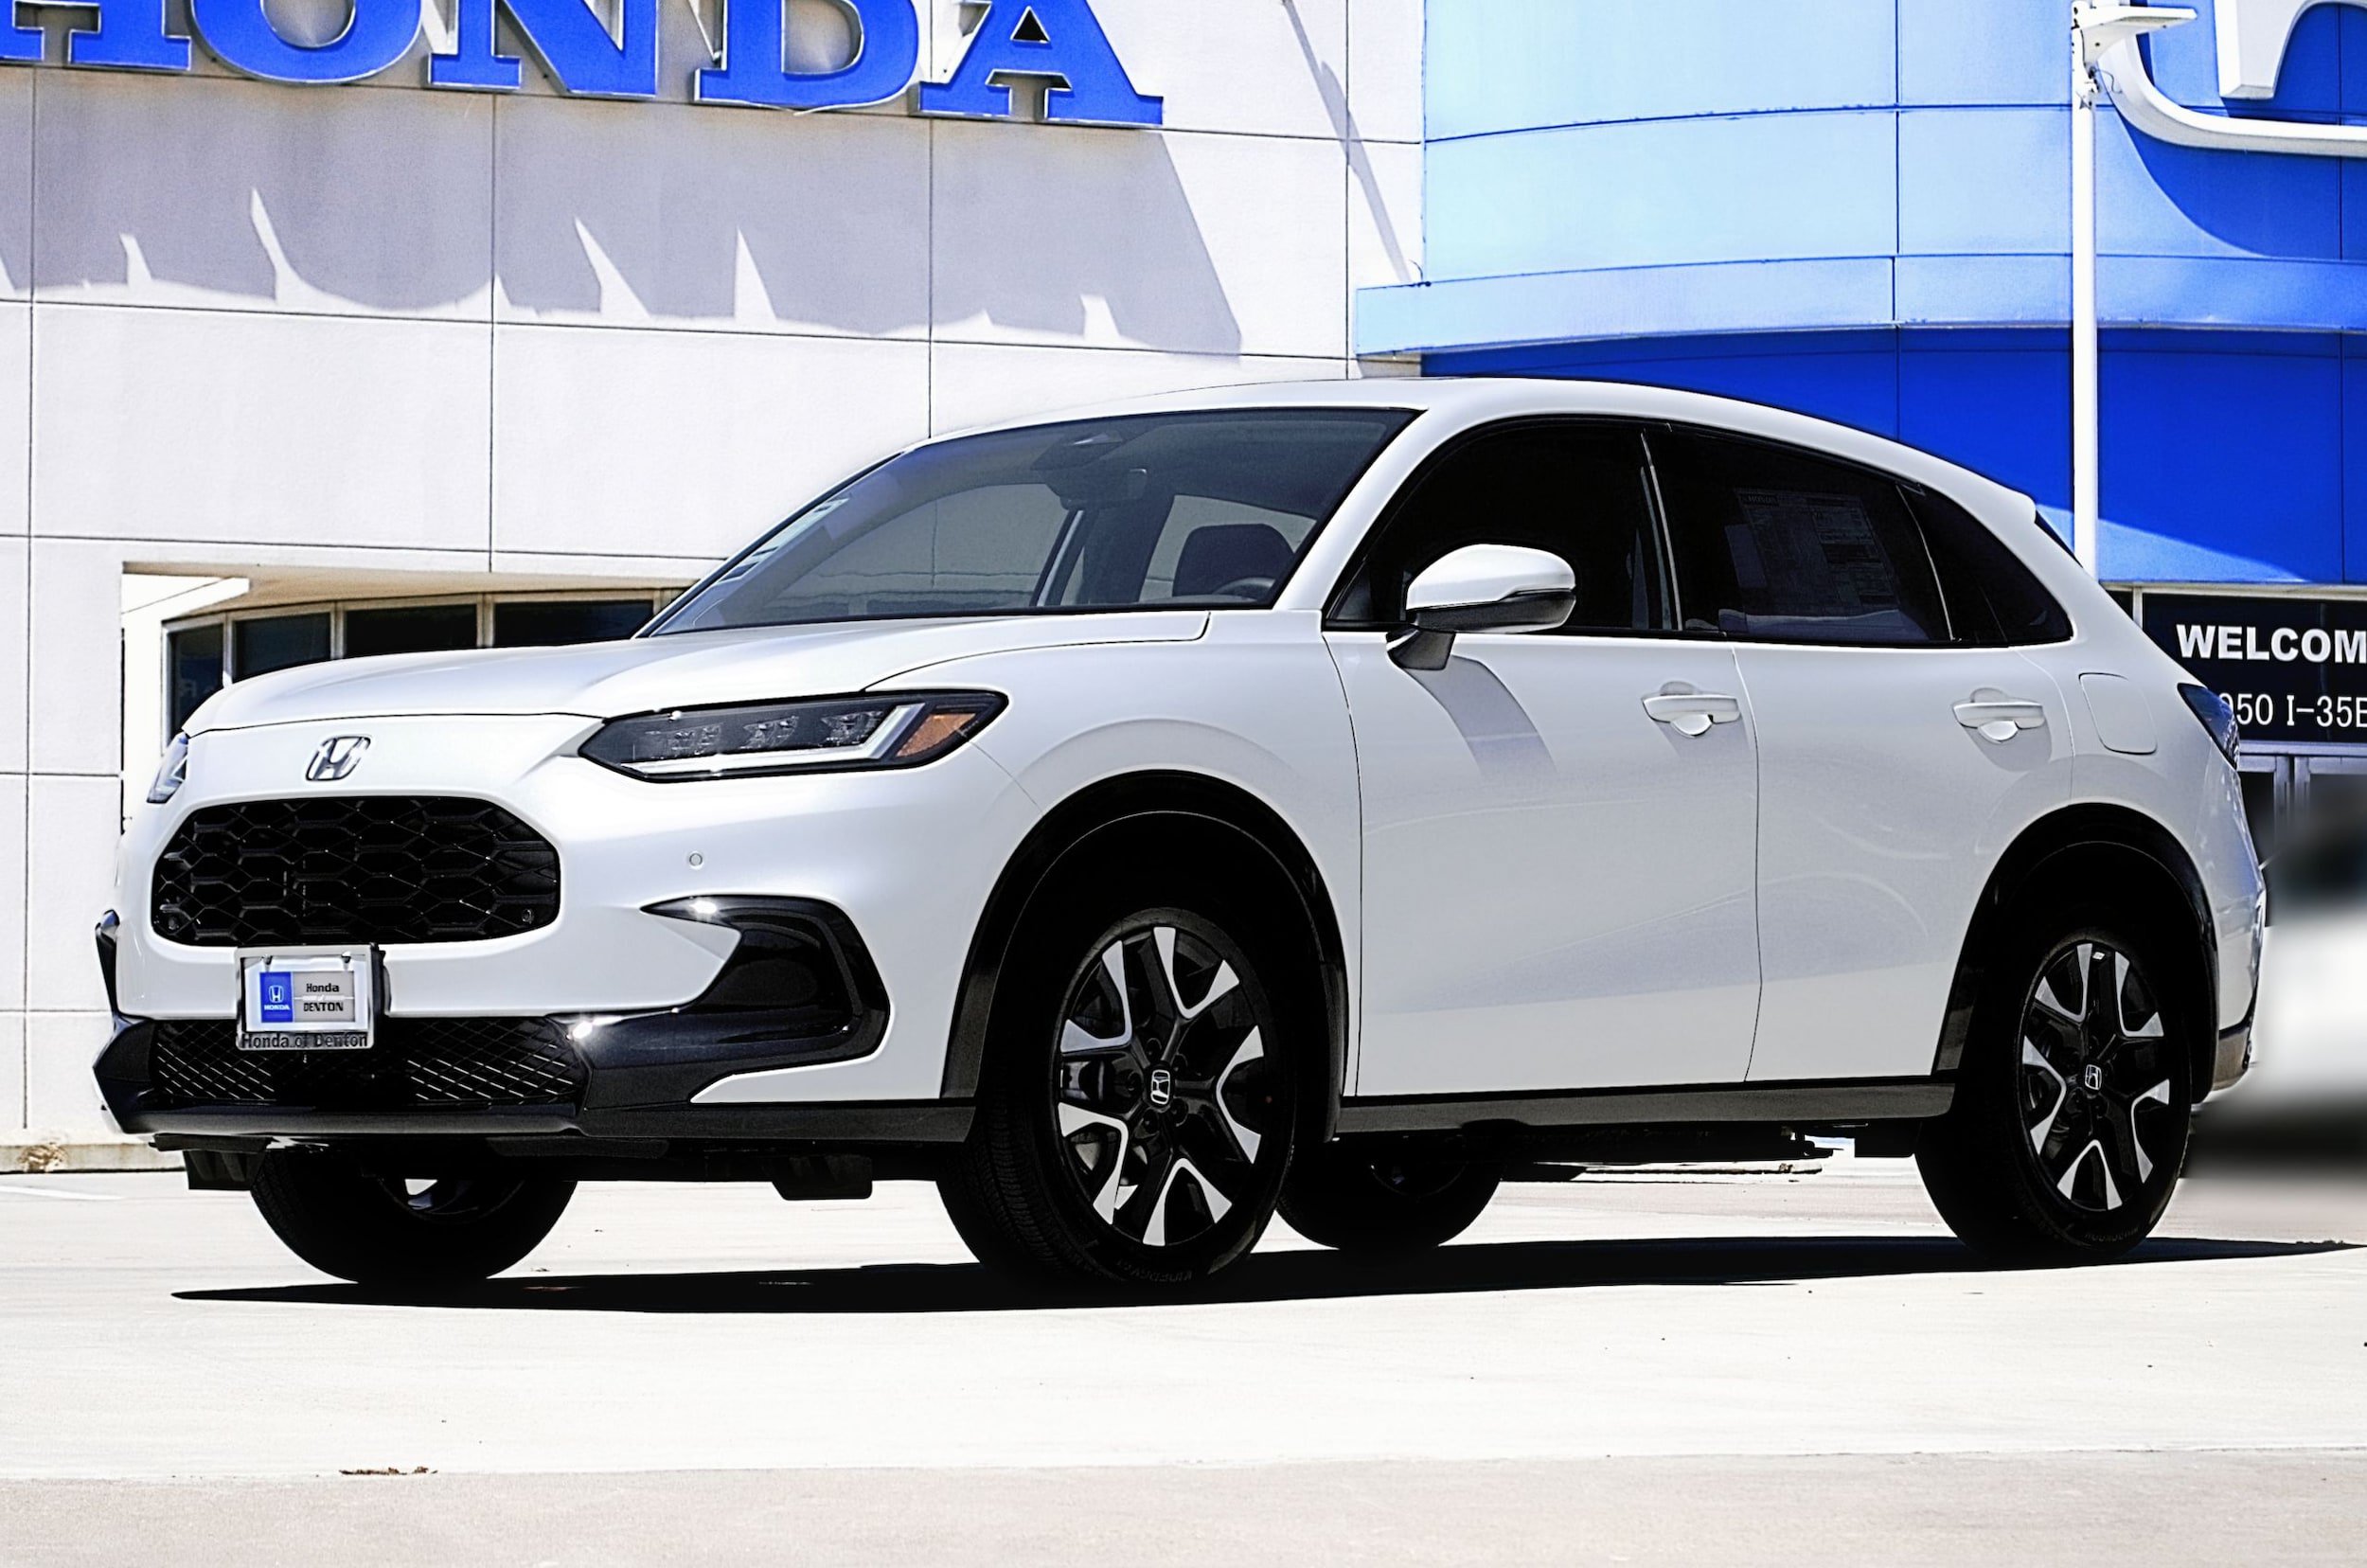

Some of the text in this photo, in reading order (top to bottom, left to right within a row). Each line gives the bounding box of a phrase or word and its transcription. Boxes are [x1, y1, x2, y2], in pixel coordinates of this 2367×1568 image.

[2176, 624, 2367, 664] WELCOM
[306, 983, 340, 992] Honda
[303, 1002, 344, 1012] DENTON
[241, 1031, 367, 1048] Honda of Denton
